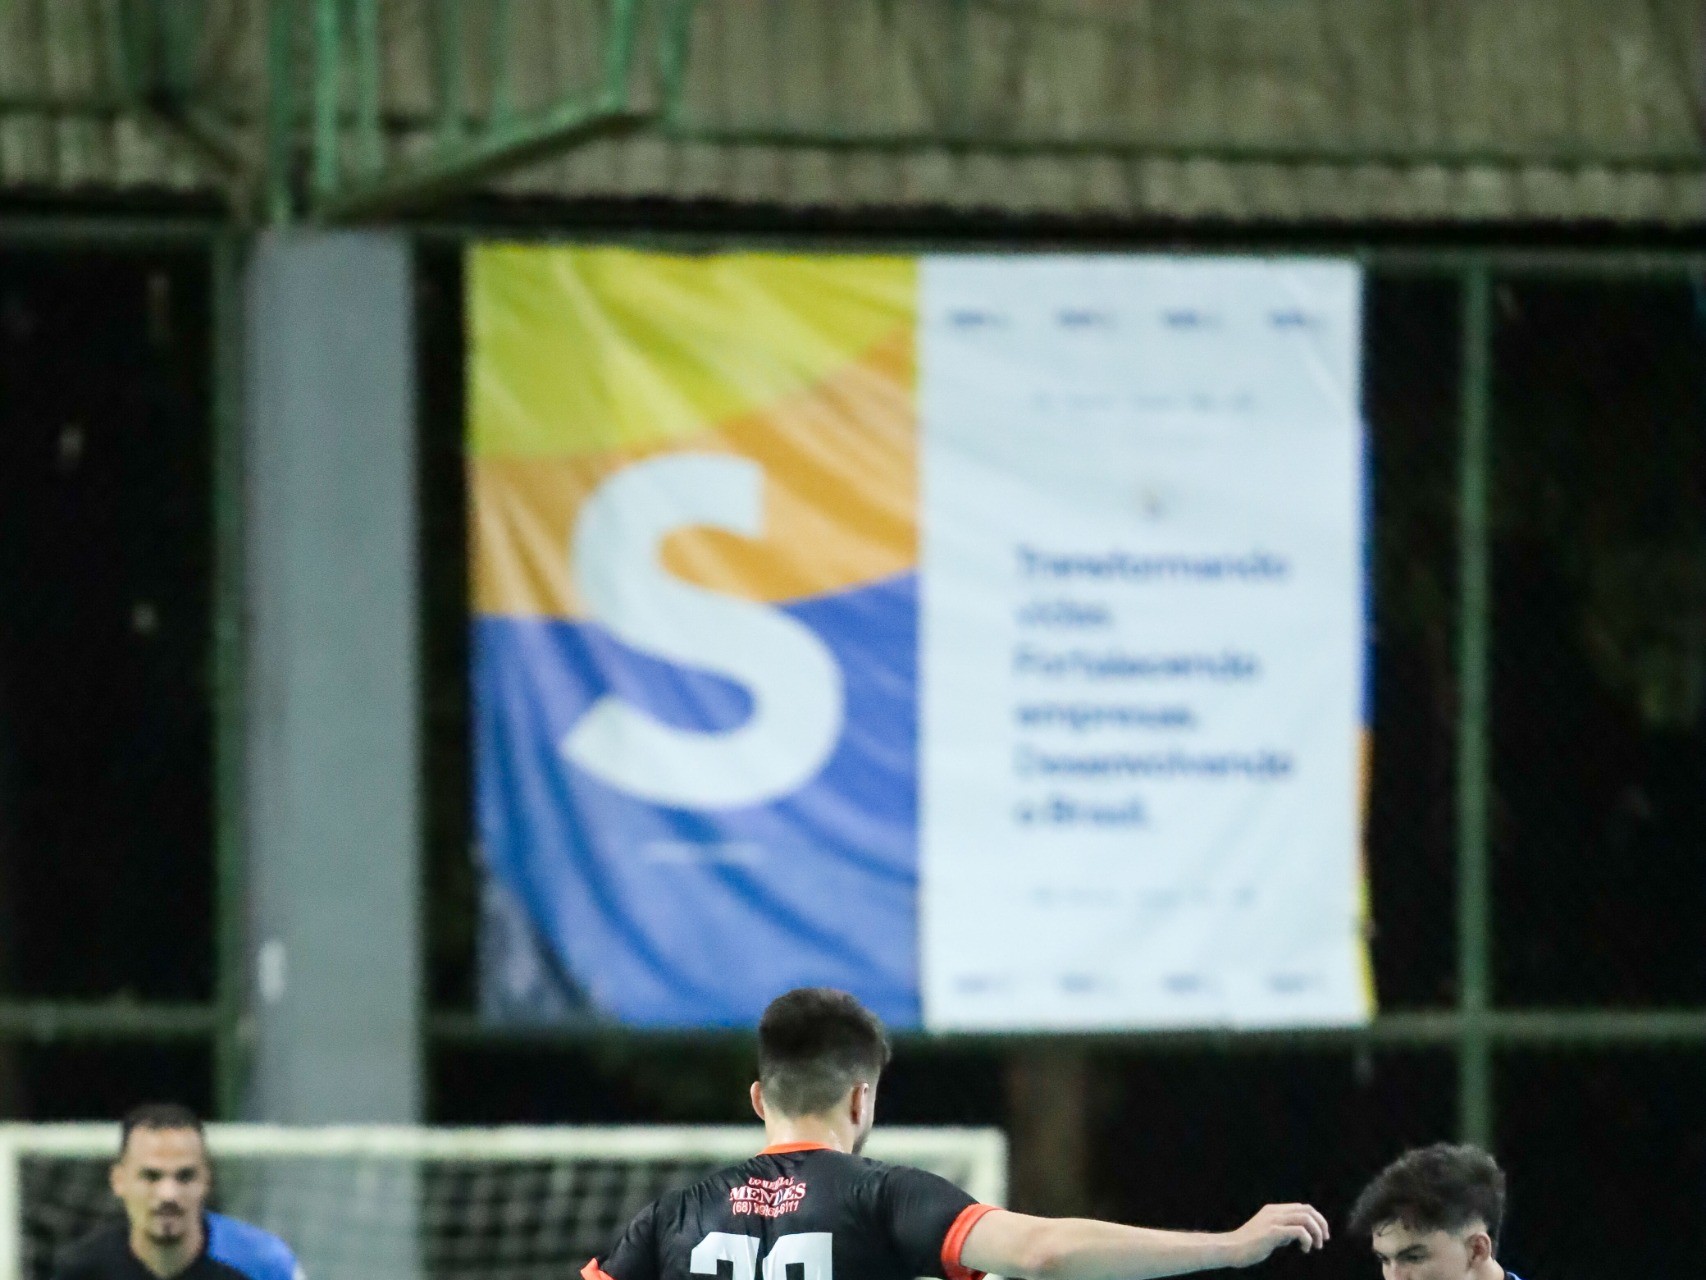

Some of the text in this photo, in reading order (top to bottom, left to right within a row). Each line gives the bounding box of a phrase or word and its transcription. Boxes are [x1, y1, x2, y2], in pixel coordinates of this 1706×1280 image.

[560, 452, 844, 806] S
[729, 1182, 807, 1206] MENDES
[732, 1201, 752, 1215] (68)
